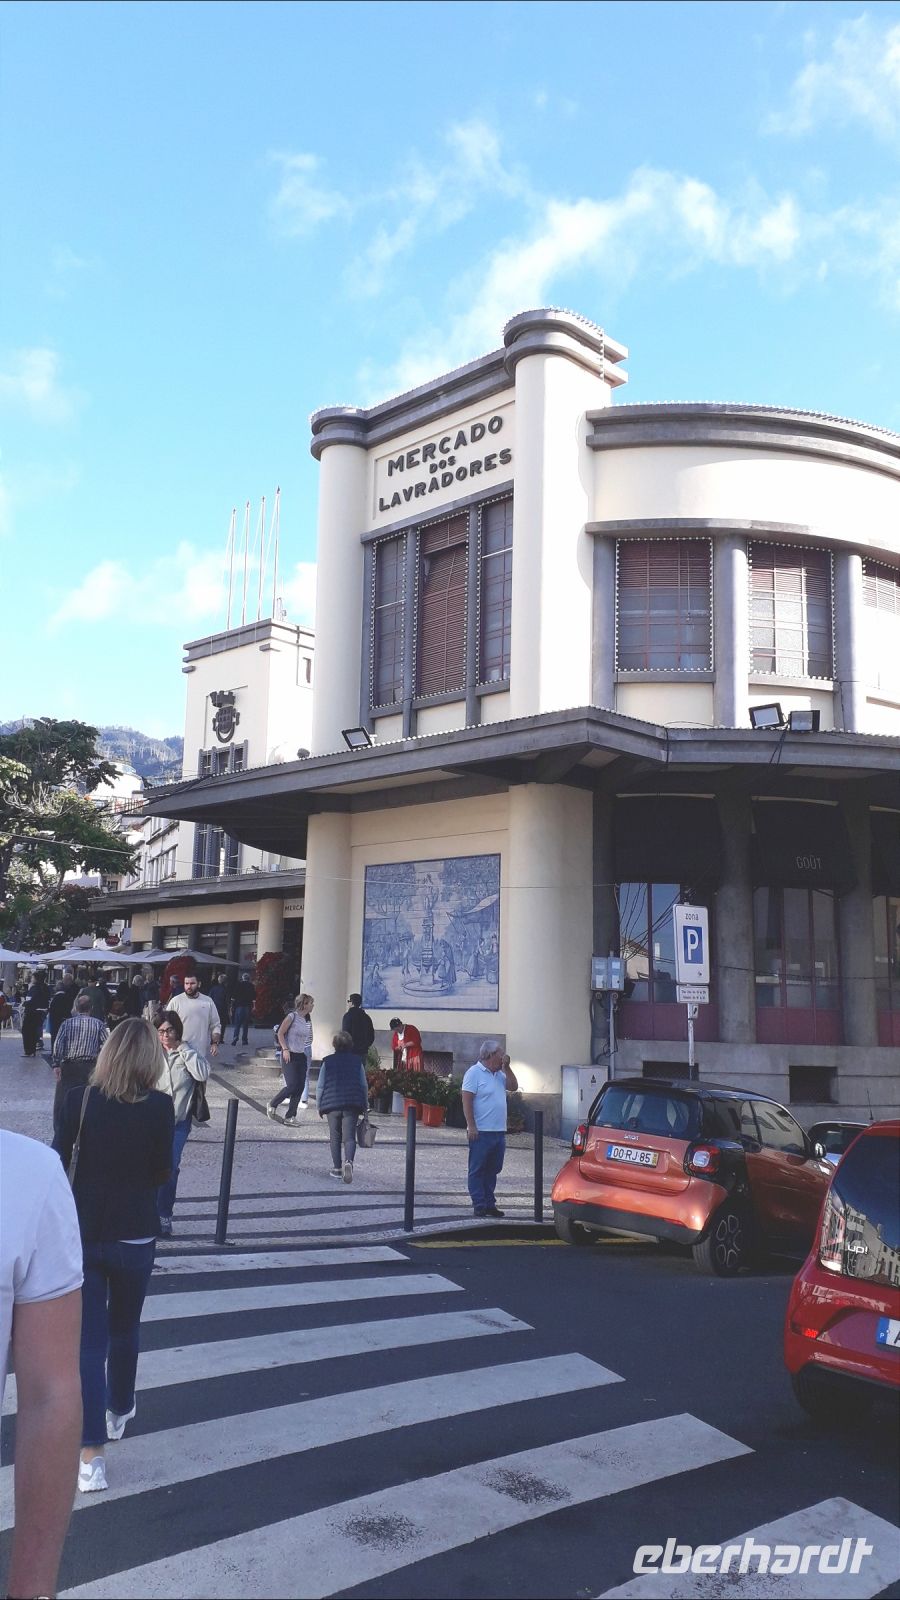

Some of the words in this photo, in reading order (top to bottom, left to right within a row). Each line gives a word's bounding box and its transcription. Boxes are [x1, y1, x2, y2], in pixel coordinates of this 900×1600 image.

[387, 415, 503, 477] MERCADO
[429, 455, 456, 474] DOS
[379, 448, 512, 512] LAVRADORES
[685, 913, 699, 921] zona
[687, 929, 699, 961] P
[847, 1244, 868, 1255] up!
